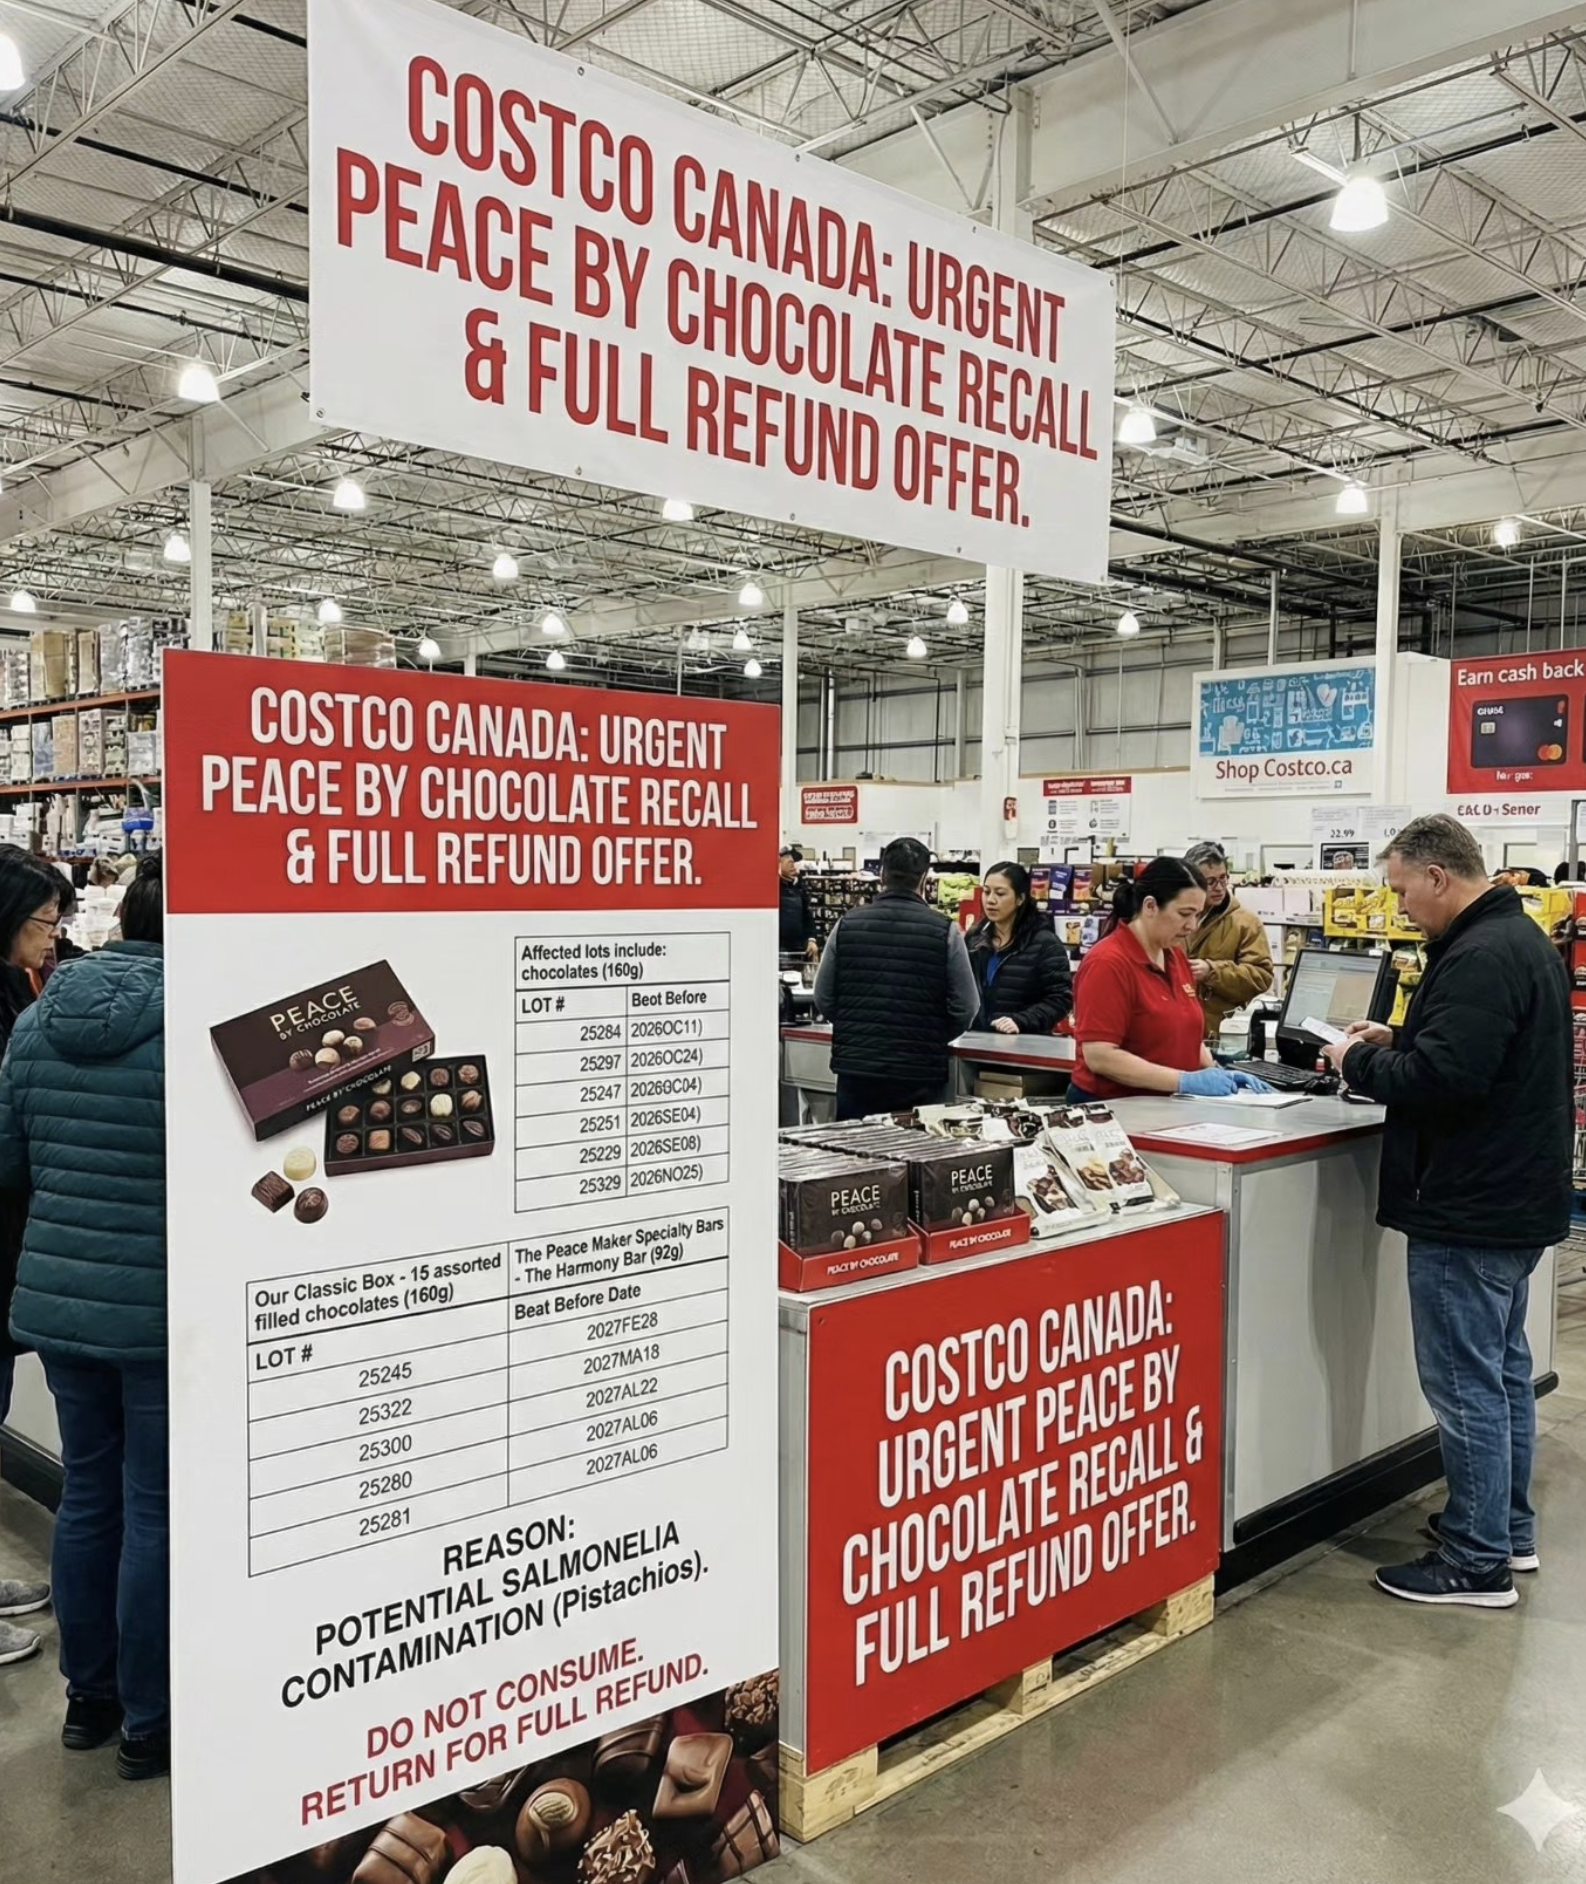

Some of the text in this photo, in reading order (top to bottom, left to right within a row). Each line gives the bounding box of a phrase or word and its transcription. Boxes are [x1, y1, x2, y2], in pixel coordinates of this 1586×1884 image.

[408, 55, 1065, 363] COSTCO CANADA: URGENT
[336, 147, 1098, 461] PEACE BY CHOCOLATE RECALL
[465, 308, 1030, 527] & FULL REFUND OFFER.
[1458, 659, 1584, 685] Earn cash back
[251, 687, 727, 770] COSTCO CANADA: URGENT
[1216, 759, 1352, 782] Shop Costco.ca
[202, 755, 757, 829] PEACE BY CHOCOLATE RECALL
[287, 829, 702, 885] & FULL REFUND OFFER.
[522, 942, 666, 960] Affected lots include:
[522, 962, 643, 980] chocolates (160g)
[270, 986, 357, 1032] PEACE
[522, 996, 565, 1013] LOT #
[665, 990, 707, 1005] Before
[580, 1024, 621, 1041] 25284
[580, 1055, 621, 1072] 25297
[580, 1084, 621, 1102] 25247
[580, 1115, 620, 1133] 25251
[631, 1106, 701, 1127] 2026SE04)
[580, 1145, 621, 1163] 25229
[631, 1135, 701, 1157] 2026SE08)
[580, 1175, 621, 1194] 25329
[631, 1164, 703, 1187] 2026NO25)
[951, 1164, 992, 1186] PEACE
[831, 1185, 880, 1208] PEACE
[515, 1216, 724, 1264] The Peace Maker Specialty Bars
[525, 1266, 552, 1284] The
[556, 1254, 619, 1280] Harmony
[623, 1248, 647, 1265] Bar
[650, 1242, 683, 1265] (92g)
[255, 1289, 295, 1308] Our
[300, 1276, 357, 1302] Classic
[362, 1271, 396, 1292] Box
[410, 1265, 430, 1282] 15
[433, 1252, 501, 1279] assorted
[255, 1283, 454, 1331] filled chocolates (160g)
[514, 1284, 641, 1320] Beat Before Date
[587, 1312, 658, 1341] 2027FE28
[256, 1345, 313, 1370] LOT #
[583, 1344, 660, 1375] 2027MA18
[885, 1279, 1172, 1422] COSTCO CANADA:
[359, 1362, 412, 1388] 25245
[586, 1377, 658, 1408] 2027AL22
[359, 1398, 412, 1425] 25322
[586, 1411, 658, 1442] 2027AL06
[879, 1344, 1180, 1508] URGENT PEACE BY
[359, 1435, 412, 1461] 25300
[586, 1444, 658, 1475] 2027AL06
[359, 1471, 412, 1498] 25280
[843, 1405, 1203, 1605] CHOCOLATE RECALL &
[359, 1509, 410, 1535] 25281
[443, 1514, 575, 1575] REASON:
[316, 1521, 680, 1655] POTENTIAL SALMONELIA
[855, 1480, 1196, 1686] FULL REFUND OFFER.
[282, 1550, 708, 1708] CONTAMINATION (Pistachios).
[366, 1638, 643, 1758] DO NOT CONSUME.
[302, 1653, 708, 1825] RETURN FOR FULL REFUND.
